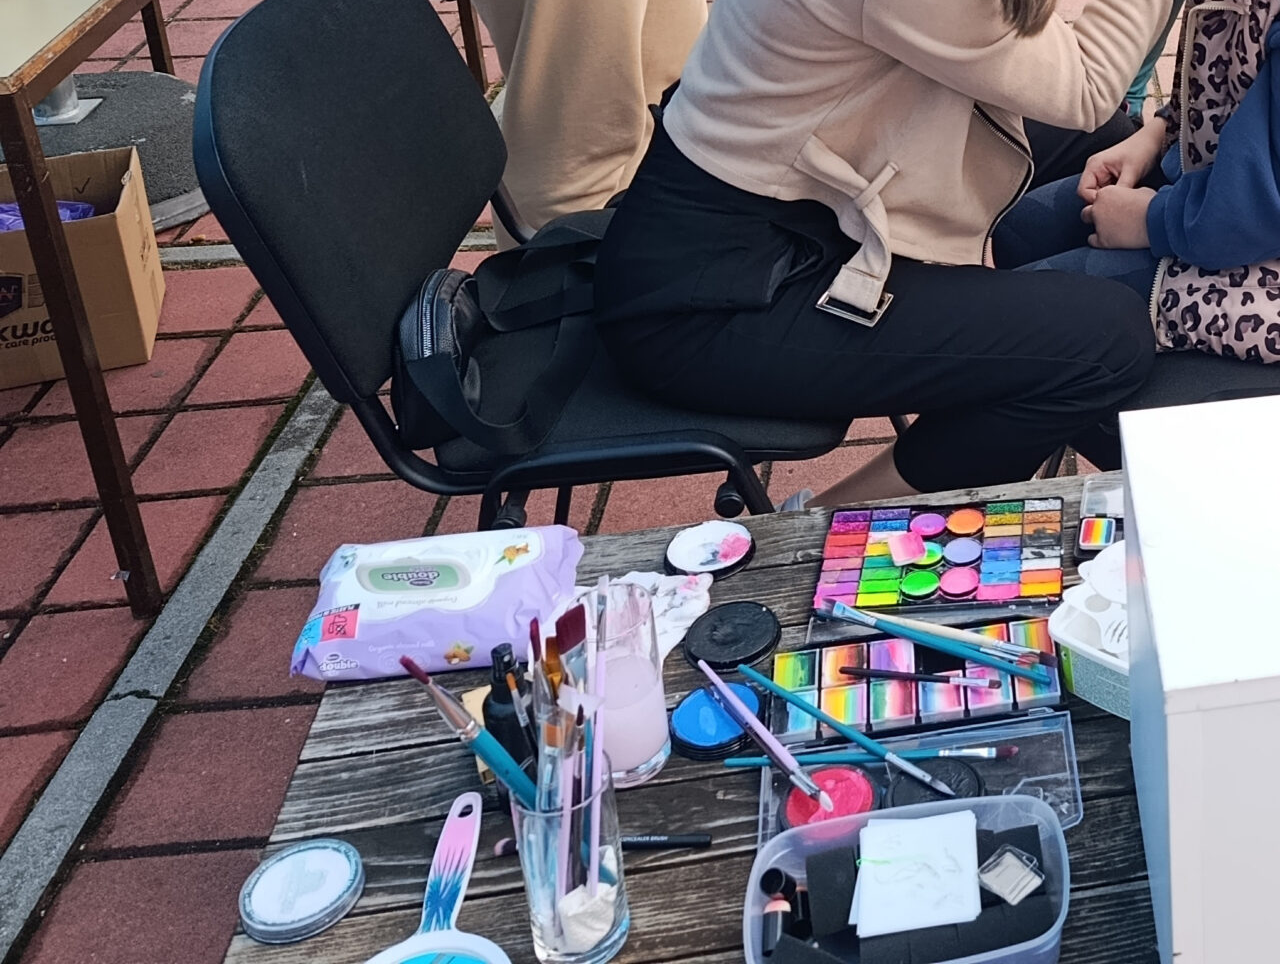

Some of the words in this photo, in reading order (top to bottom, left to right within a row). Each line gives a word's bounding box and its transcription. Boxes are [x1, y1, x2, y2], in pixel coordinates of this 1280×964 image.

[5, 338, 29, 349] care
[382, 570, 440, 582] double
[320, 660, 360, 671] double
